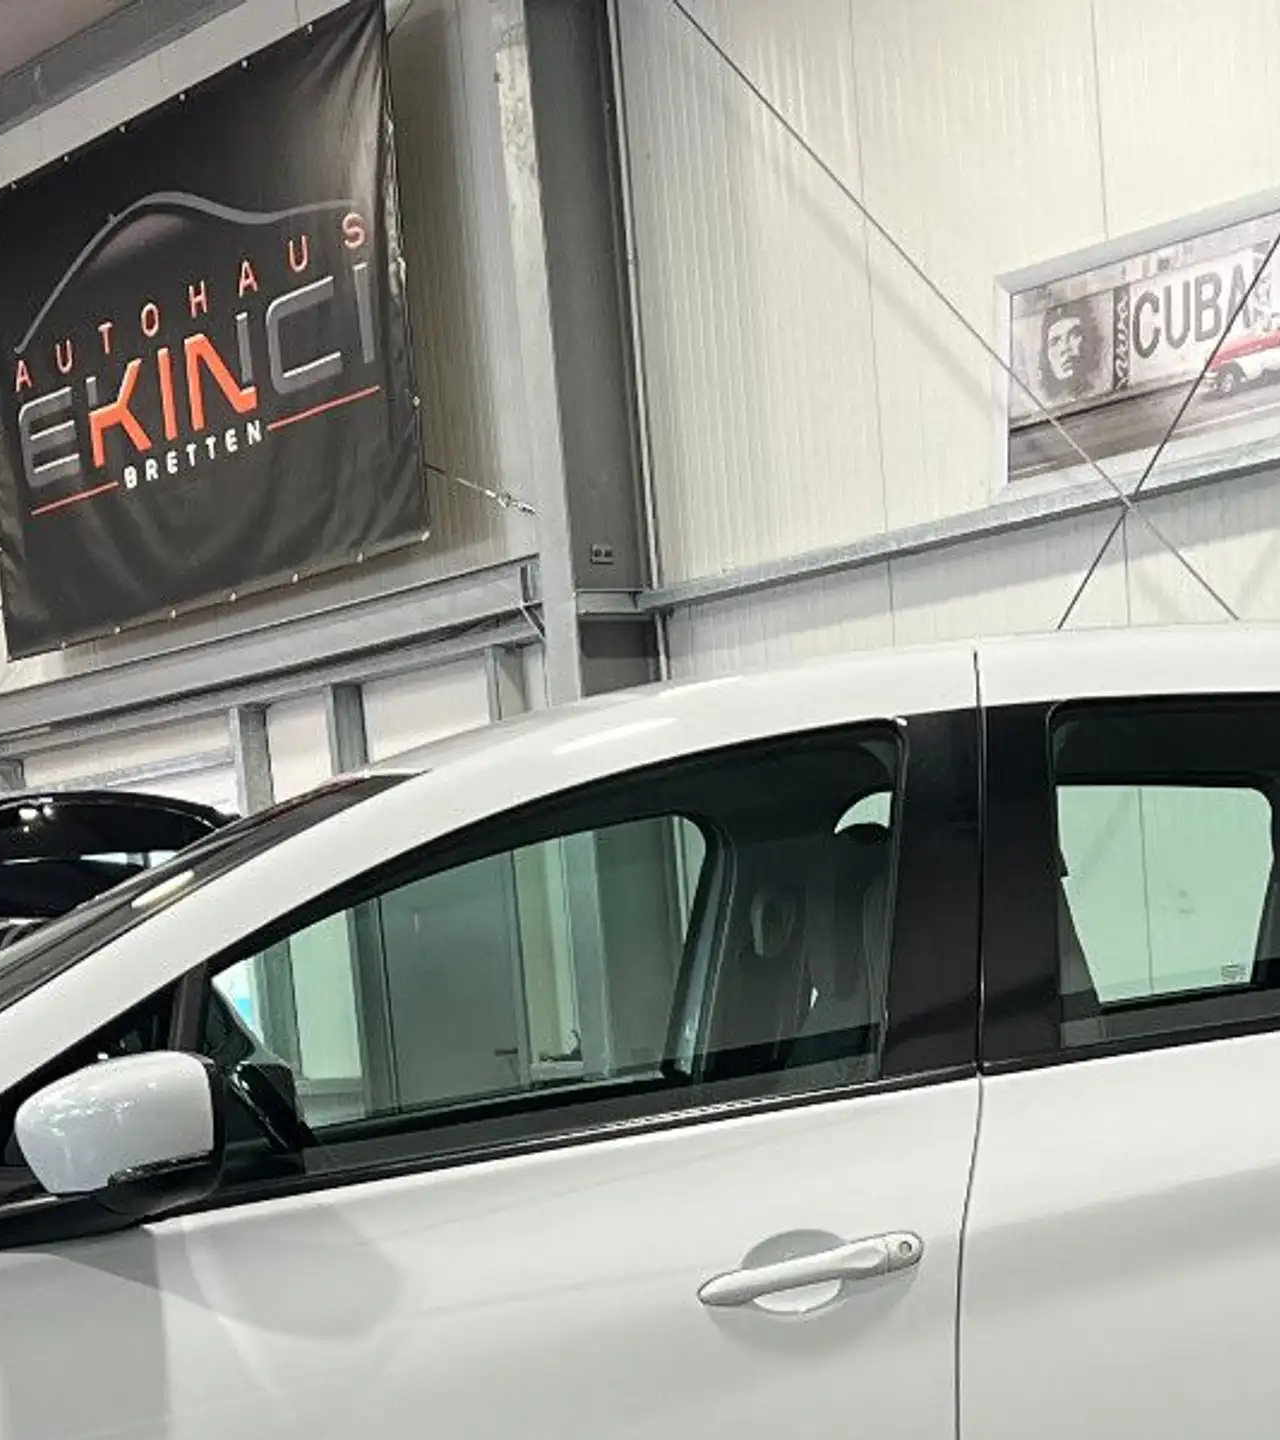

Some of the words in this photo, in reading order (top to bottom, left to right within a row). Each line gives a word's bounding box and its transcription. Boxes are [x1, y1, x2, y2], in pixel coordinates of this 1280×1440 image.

[15, 213, 366, 392] AUTOHAUS
[1132, 264, 1251, 359] CUBA
[19, 262, 375, 488] EKINCI
[123, 420, 262, 488] BRETTEN
